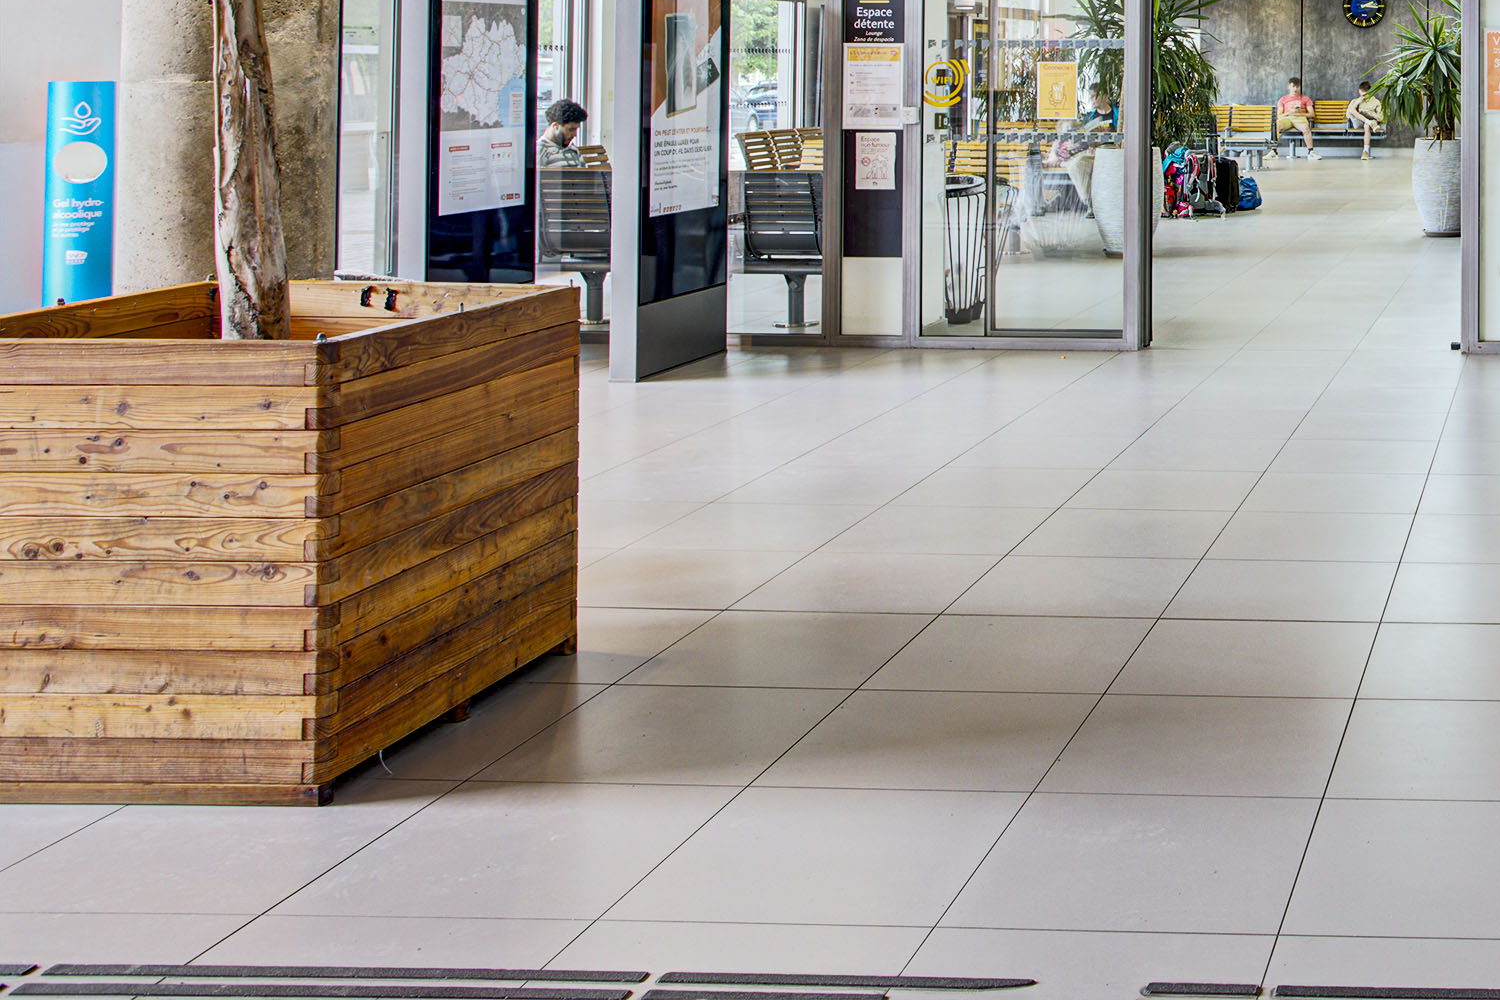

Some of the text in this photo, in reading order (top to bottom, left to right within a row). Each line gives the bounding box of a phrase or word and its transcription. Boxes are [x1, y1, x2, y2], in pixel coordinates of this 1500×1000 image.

[856, 6, 892, 19] Espace
[854, 19, 895, 29] détente
[931, 76, 952, 84] WIFI
[52, 197, 104, 210] Gel hydro-
[52, 210, 102, 220] alcoolique
